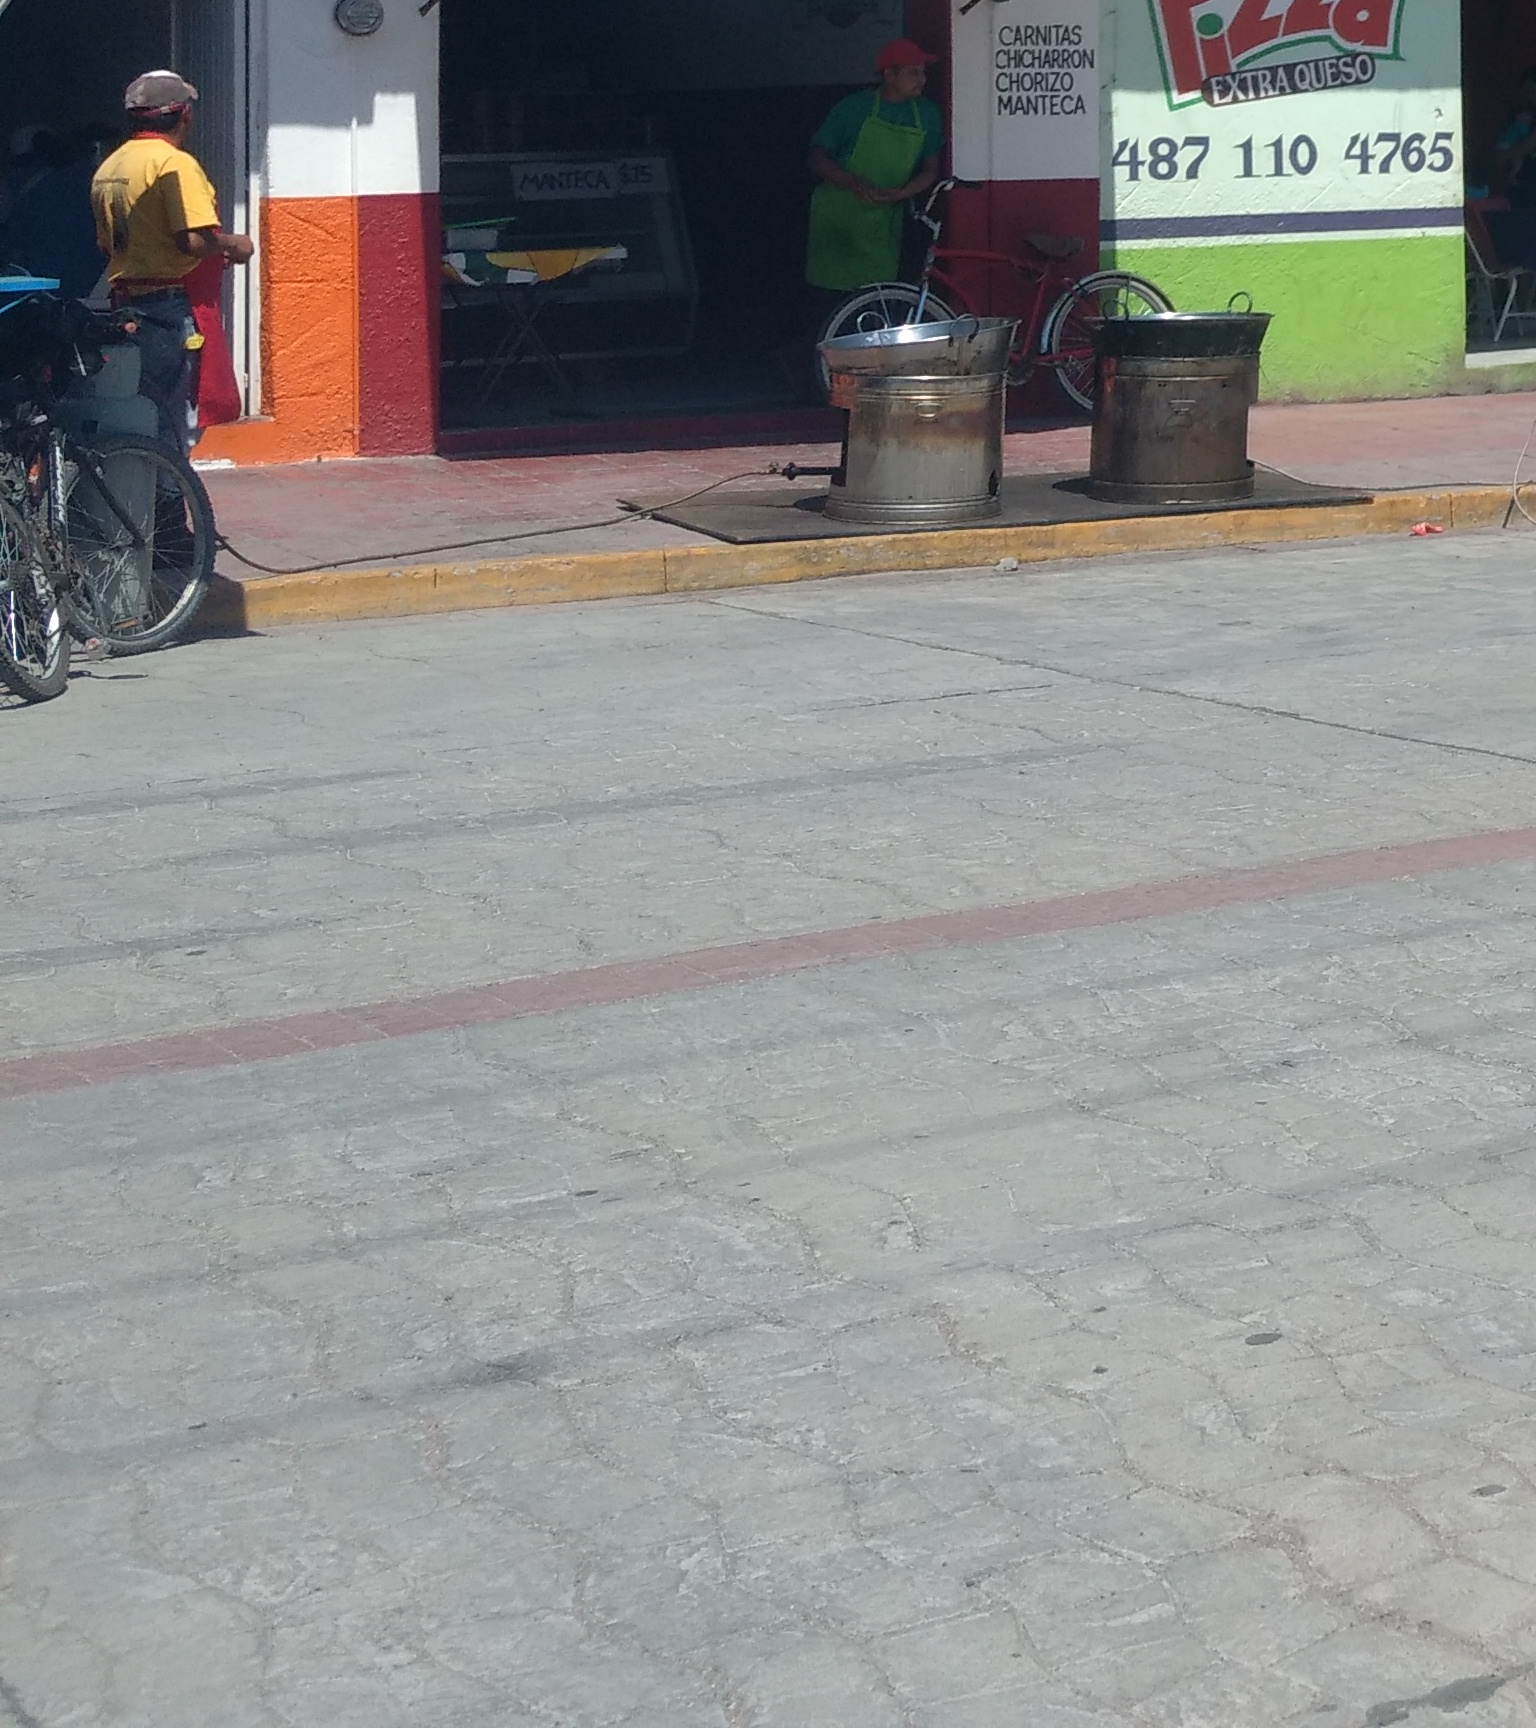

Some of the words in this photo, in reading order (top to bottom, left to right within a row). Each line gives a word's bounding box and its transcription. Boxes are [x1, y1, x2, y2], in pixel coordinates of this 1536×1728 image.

[998, 25, 1082, 46] CARNITAS
[995, 48, 1095, 69] CHICHARRON
[995, 71, 1074, 92] CHORIZO
[1210, 63, 1290, 104] EXTRA
[1296, 54, 1374, 92] QUESO
[997, 94, 1087, 115] MANTECA
[1111, 135, 1211, 182] 487
[1232, 133, 1318, 178] 110
[1344, 131, 1455, 175] 4765
